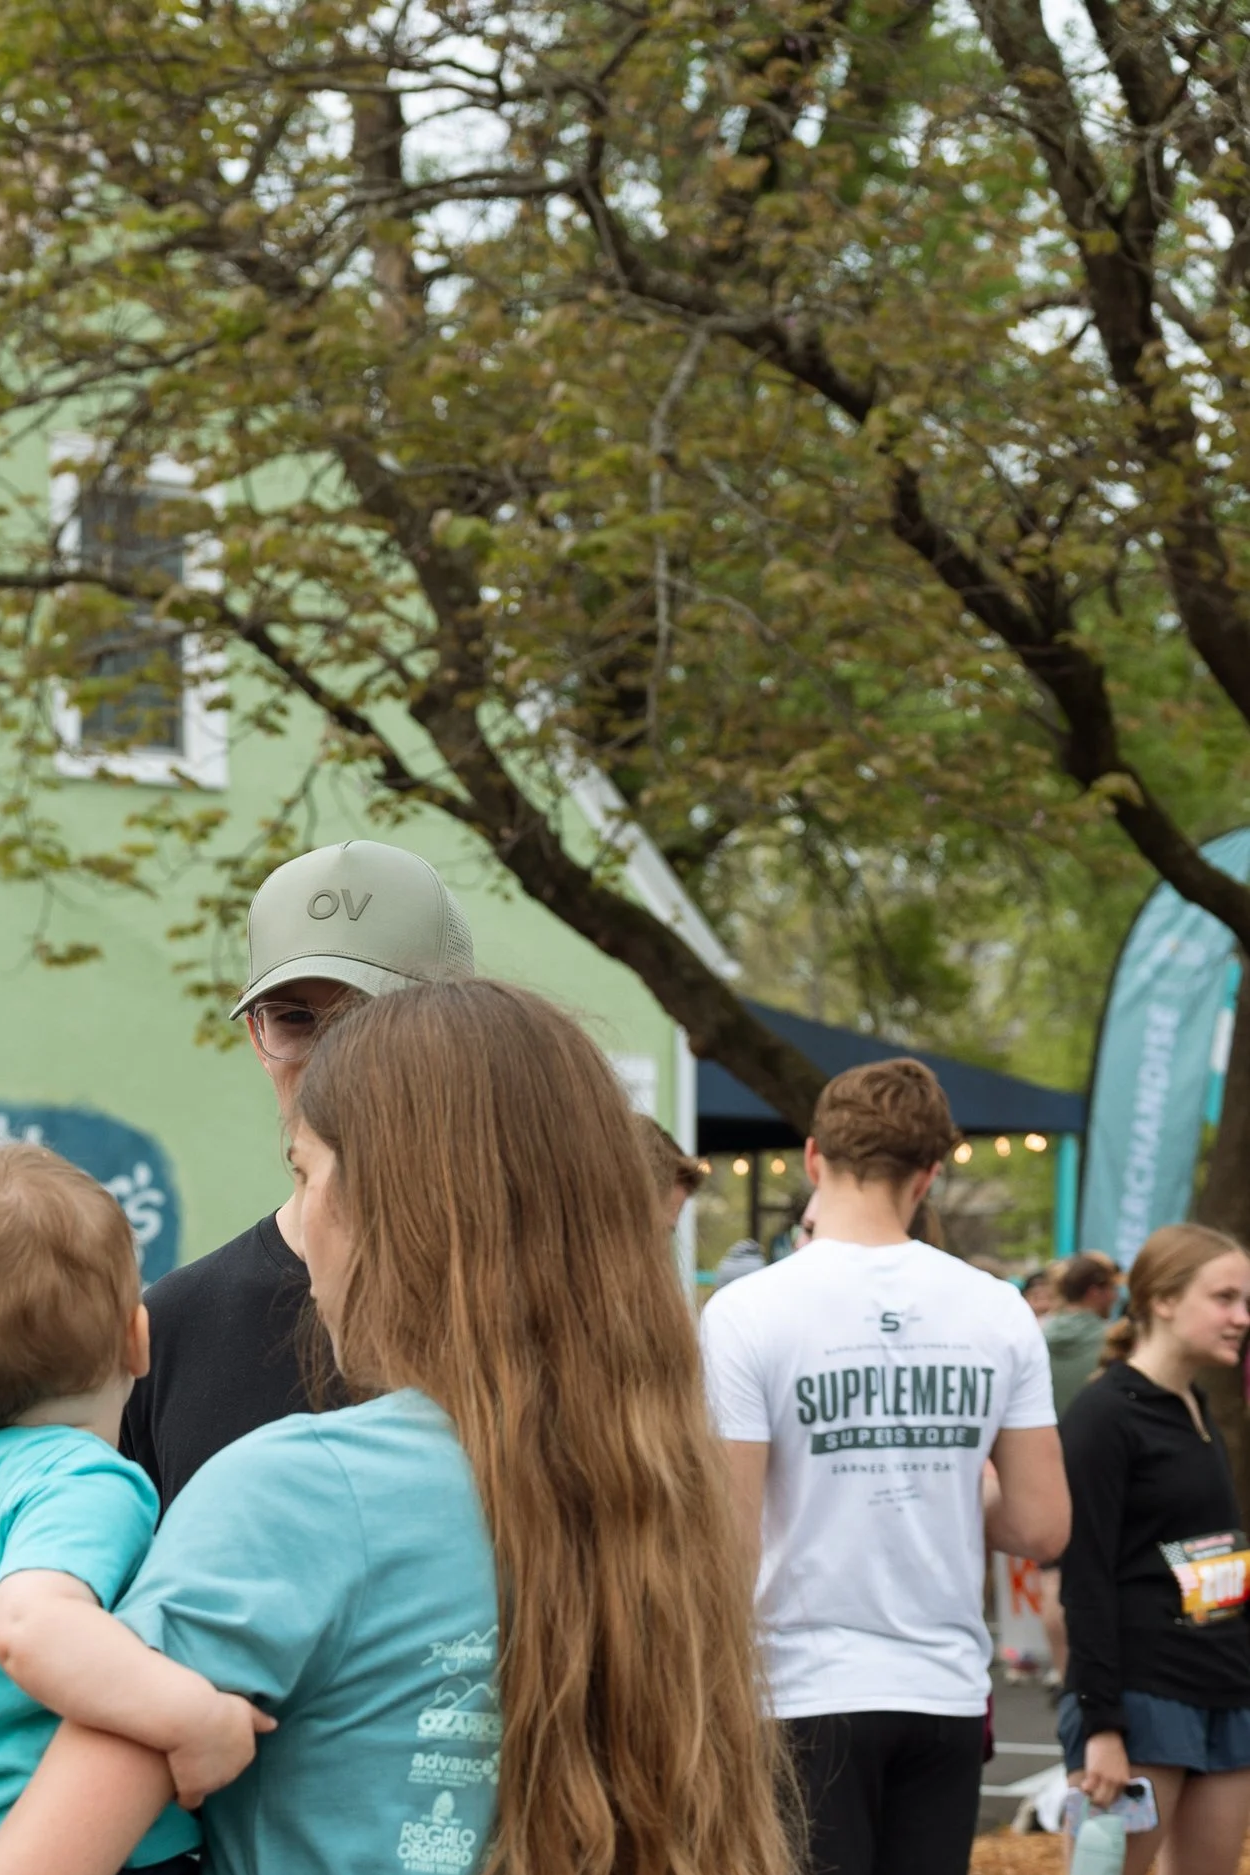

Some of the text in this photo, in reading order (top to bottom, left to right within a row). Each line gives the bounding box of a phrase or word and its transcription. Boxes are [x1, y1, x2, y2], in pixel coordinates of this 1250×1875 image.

[306, 889, 373, 921] OV
[796, 1365, 995, 1425] SUPPLEMENT
[411, 1752, 494, 1775] advance
